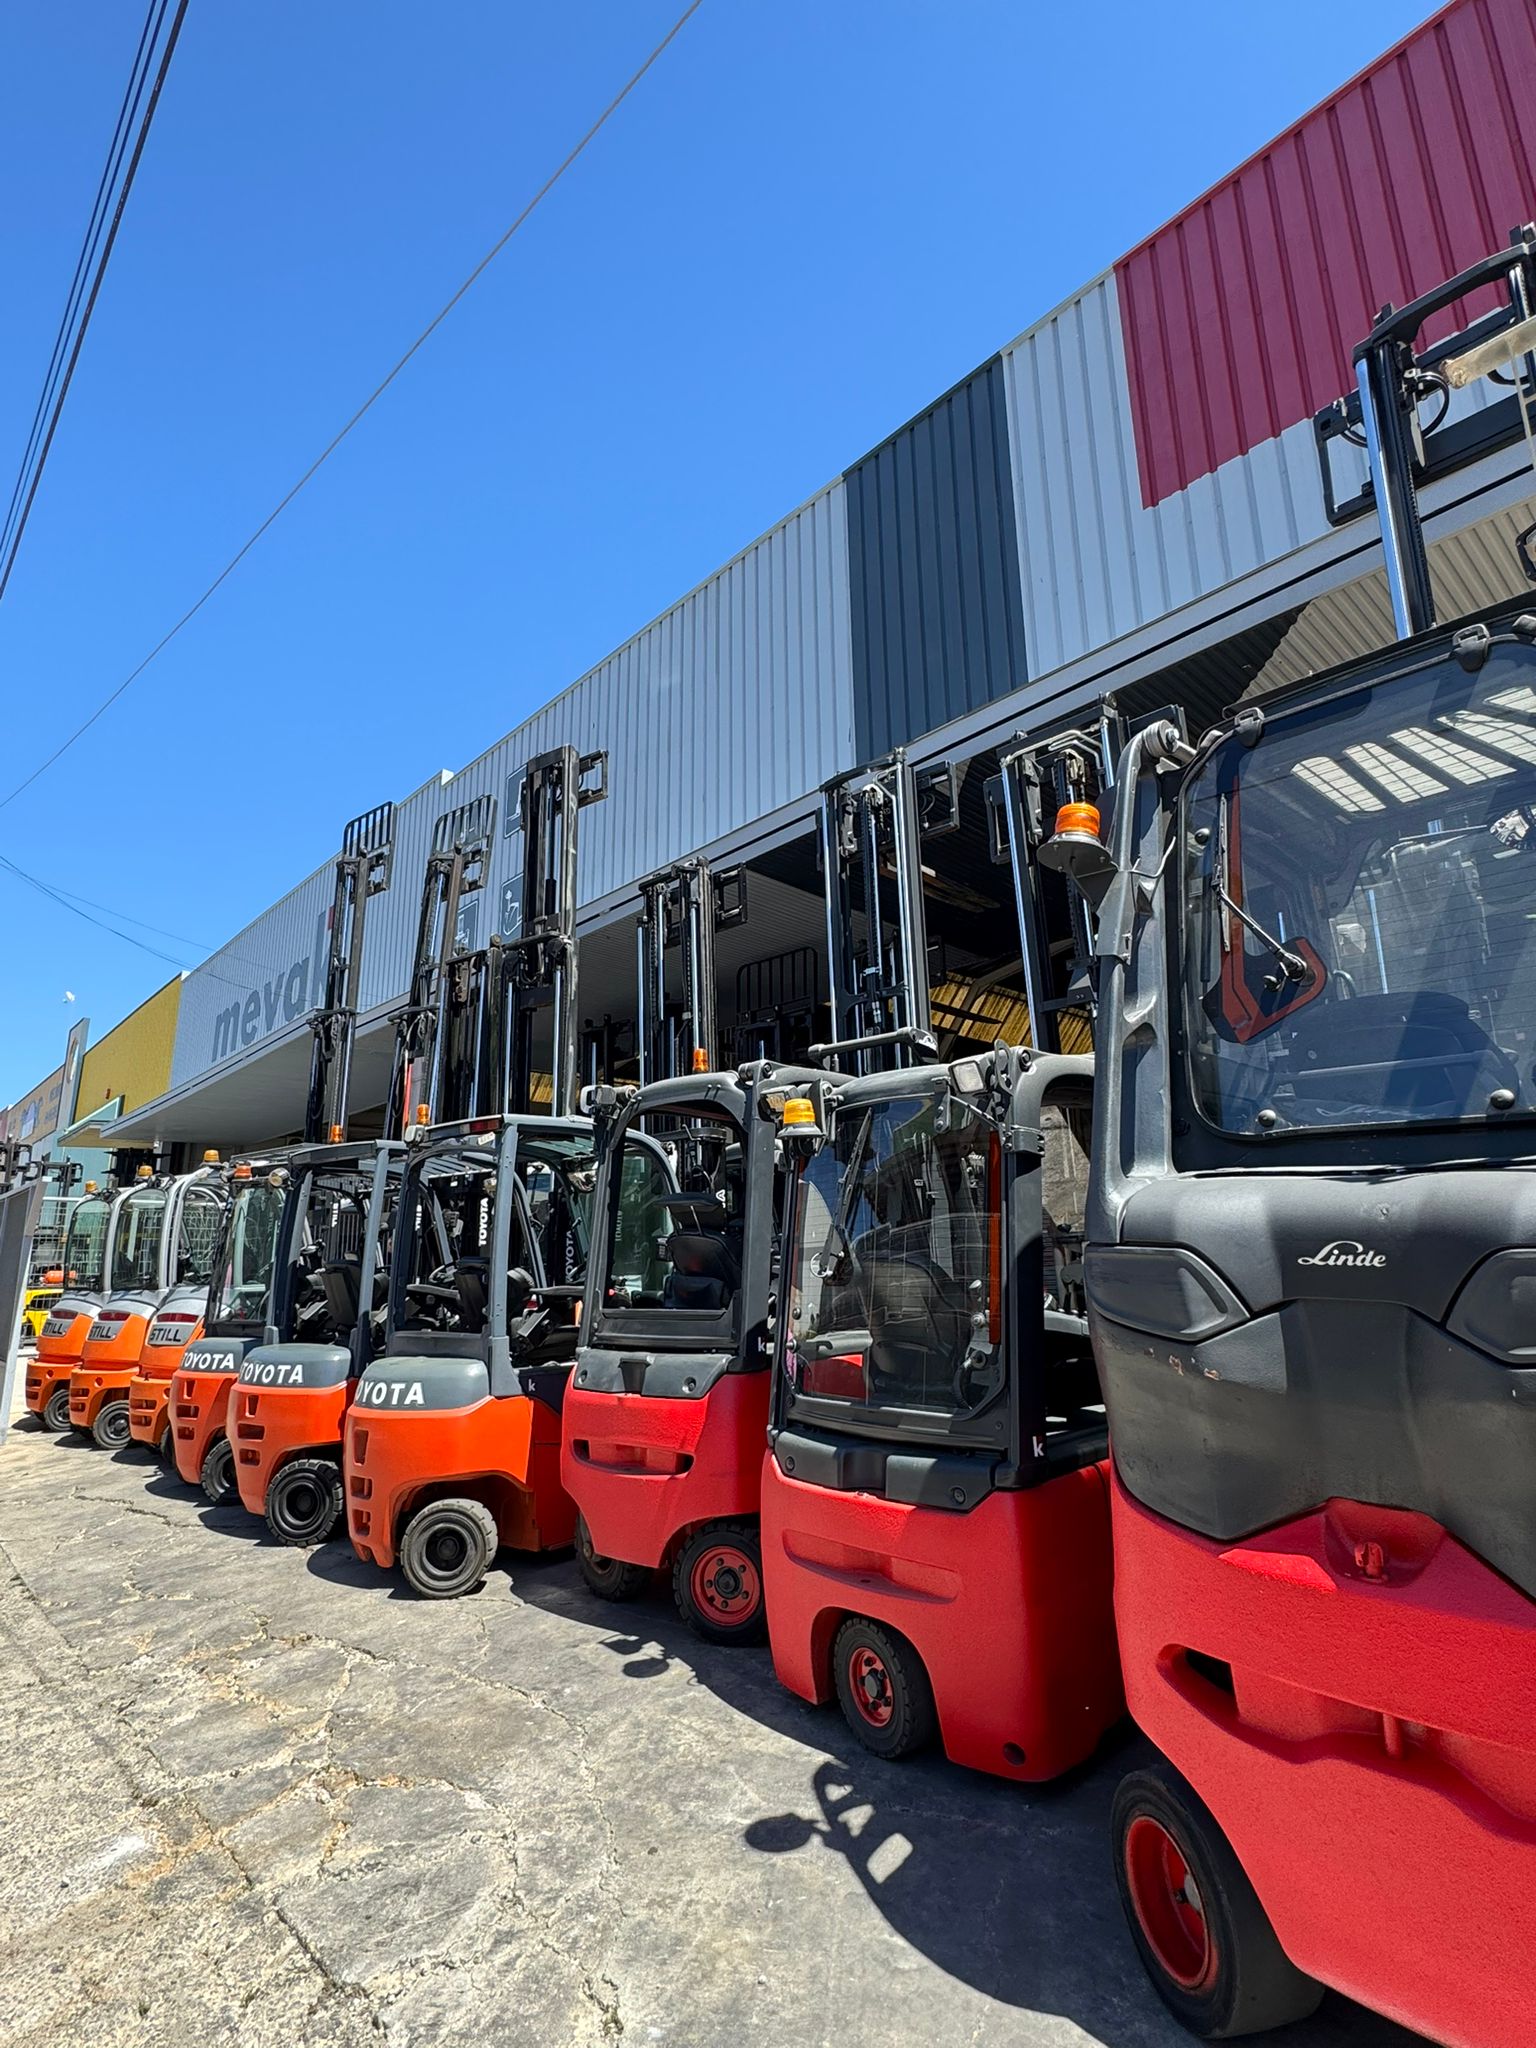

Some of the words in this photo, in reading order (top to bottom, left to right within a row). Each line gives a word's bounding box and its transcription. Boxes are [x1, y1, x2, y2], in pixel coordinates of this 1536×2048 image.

[479, 1198, 489, 1247] TOYOTA
[1298, 1241, 1387, 1268] Linde
[150, 1327, 182, 1343] STILL
[354, 1380, 425, 1405] OYOTA
[1032, 1435, 1045, 1457] k
